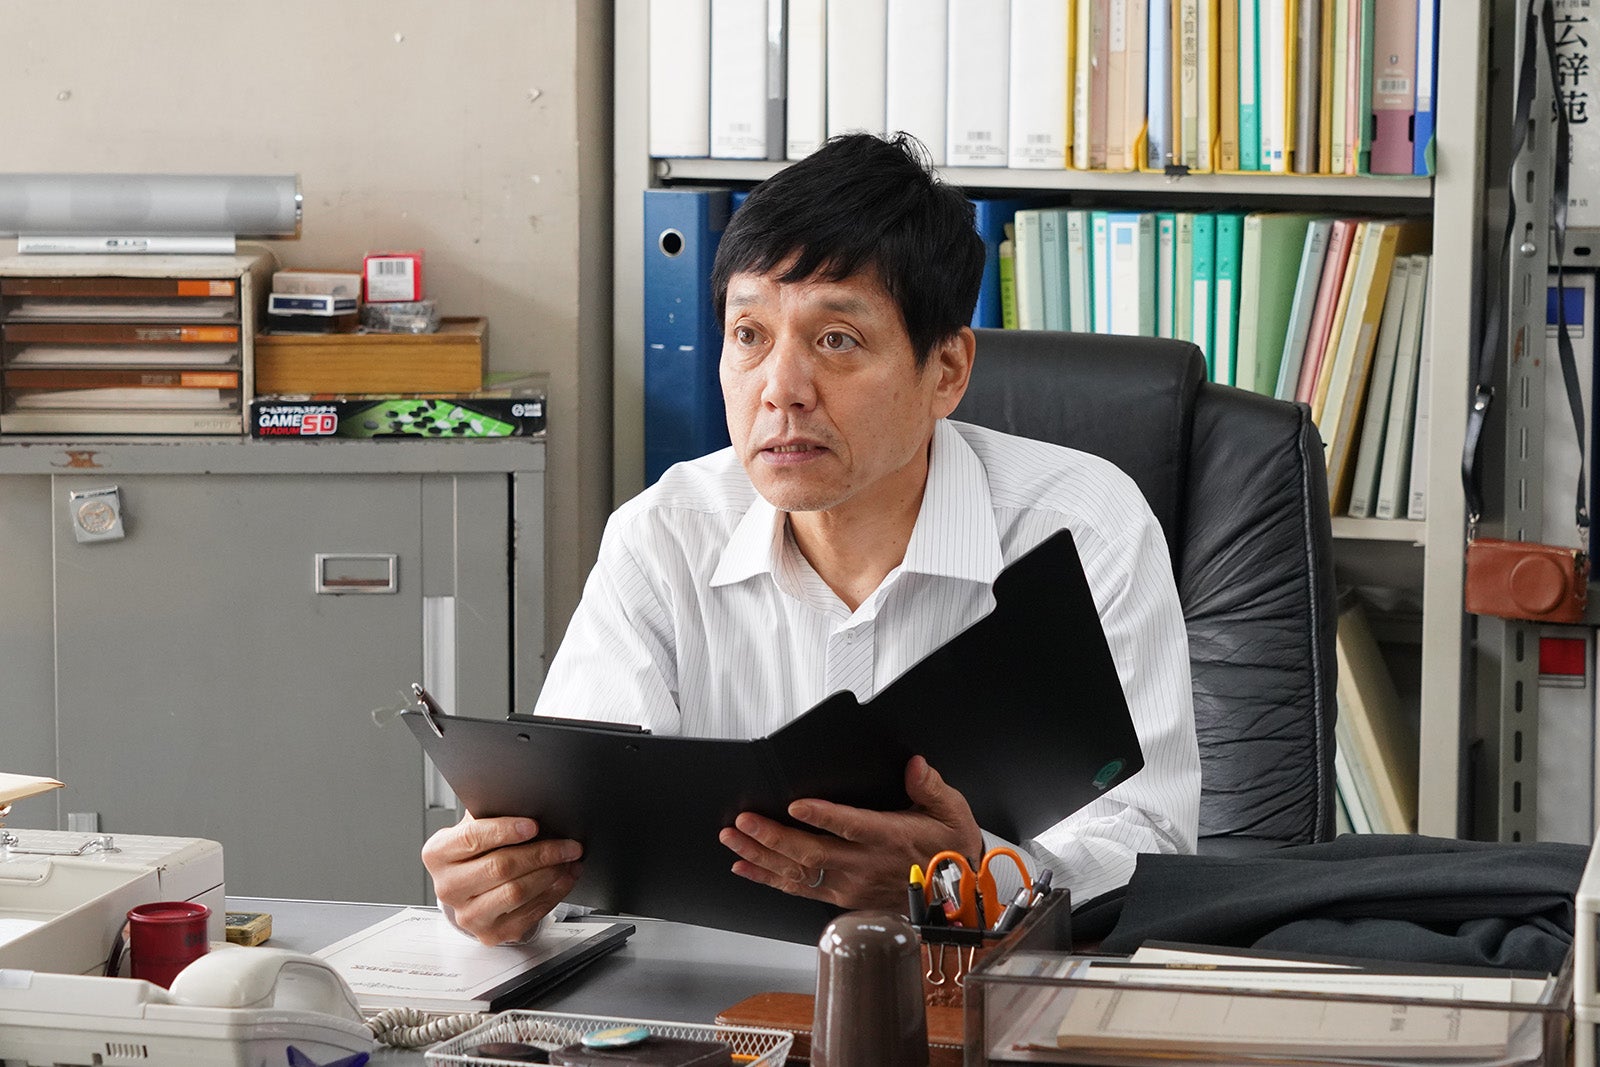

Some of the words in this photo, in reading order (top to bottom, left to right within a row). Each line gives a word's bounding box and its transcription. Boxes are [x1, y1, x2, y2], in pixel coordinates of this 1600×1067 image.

[259, 414, 302, 427] GAME
[300, 414, 338, 434] SD
[259, 427, 301, 435] STADIUM
